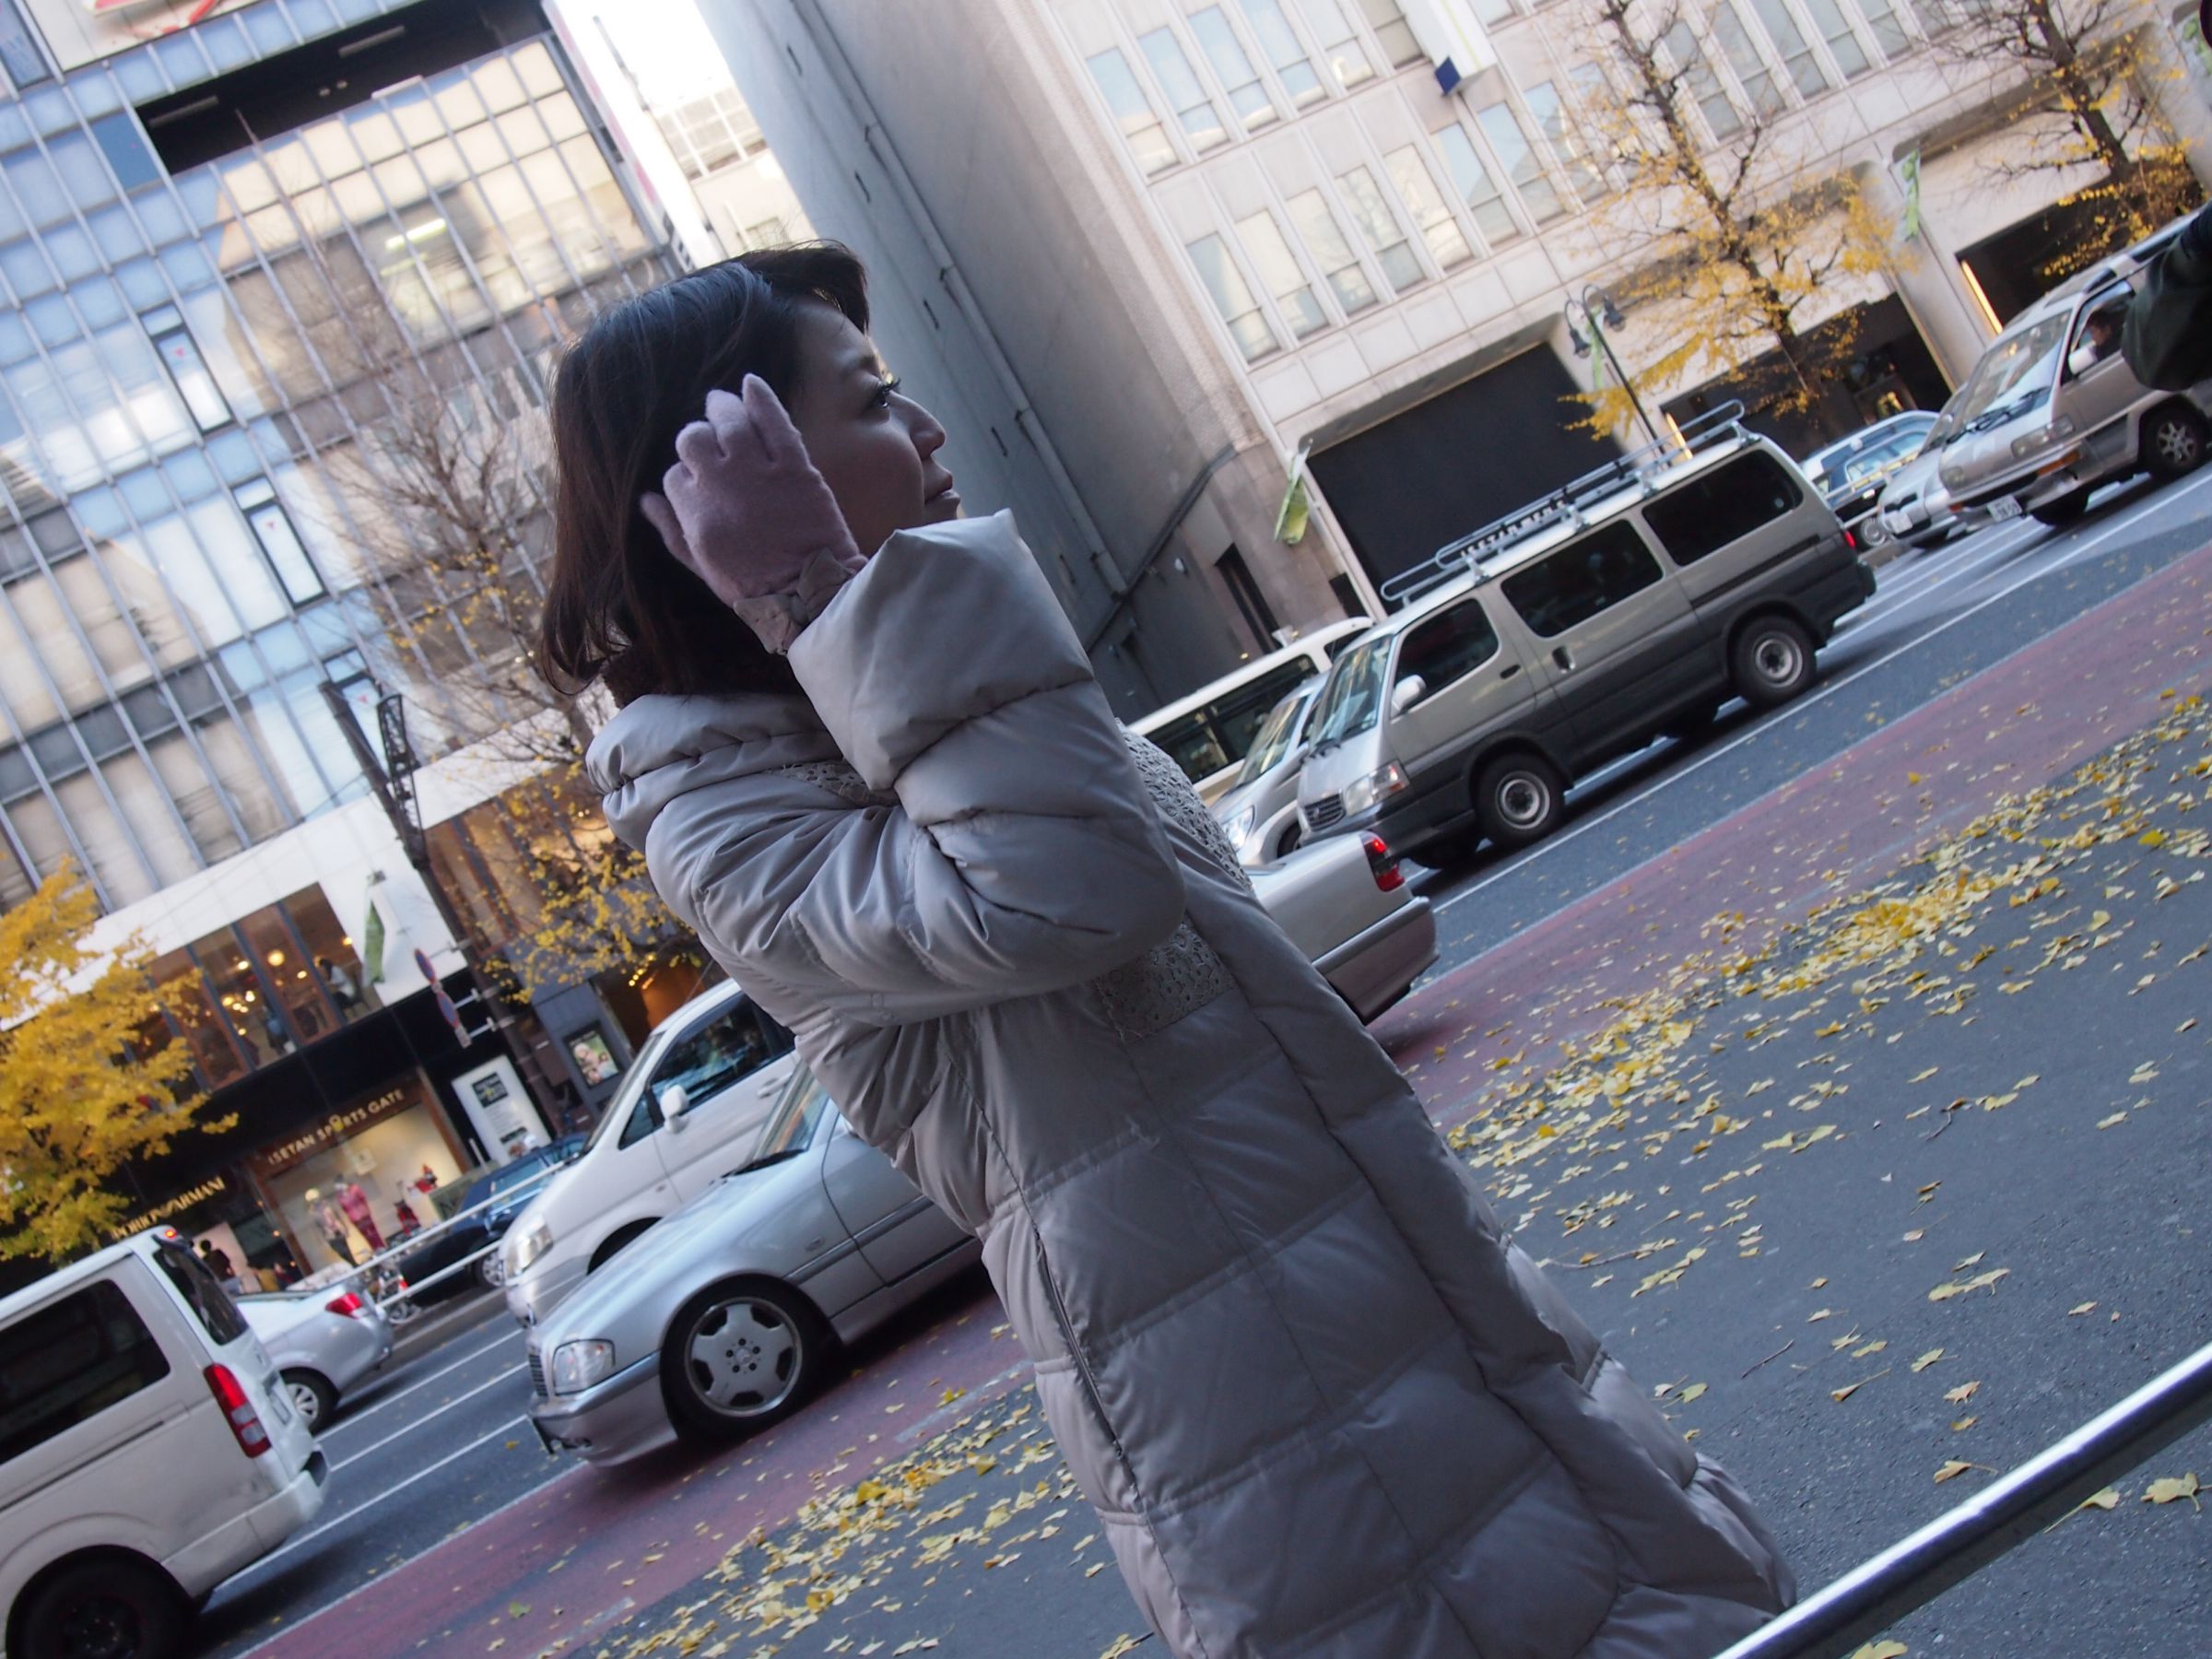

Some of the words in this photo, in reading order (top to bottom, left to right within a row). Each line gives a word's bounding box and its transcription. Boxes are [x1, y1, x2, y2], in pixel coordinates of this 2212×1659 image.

[268, 1134, 316, 1165] ISETAN
[317, 1108, 368, 1141] SPORTS
[369, 1088, 405, 1113] GATE
[173, 1175, 226, 1210] ARMANI
